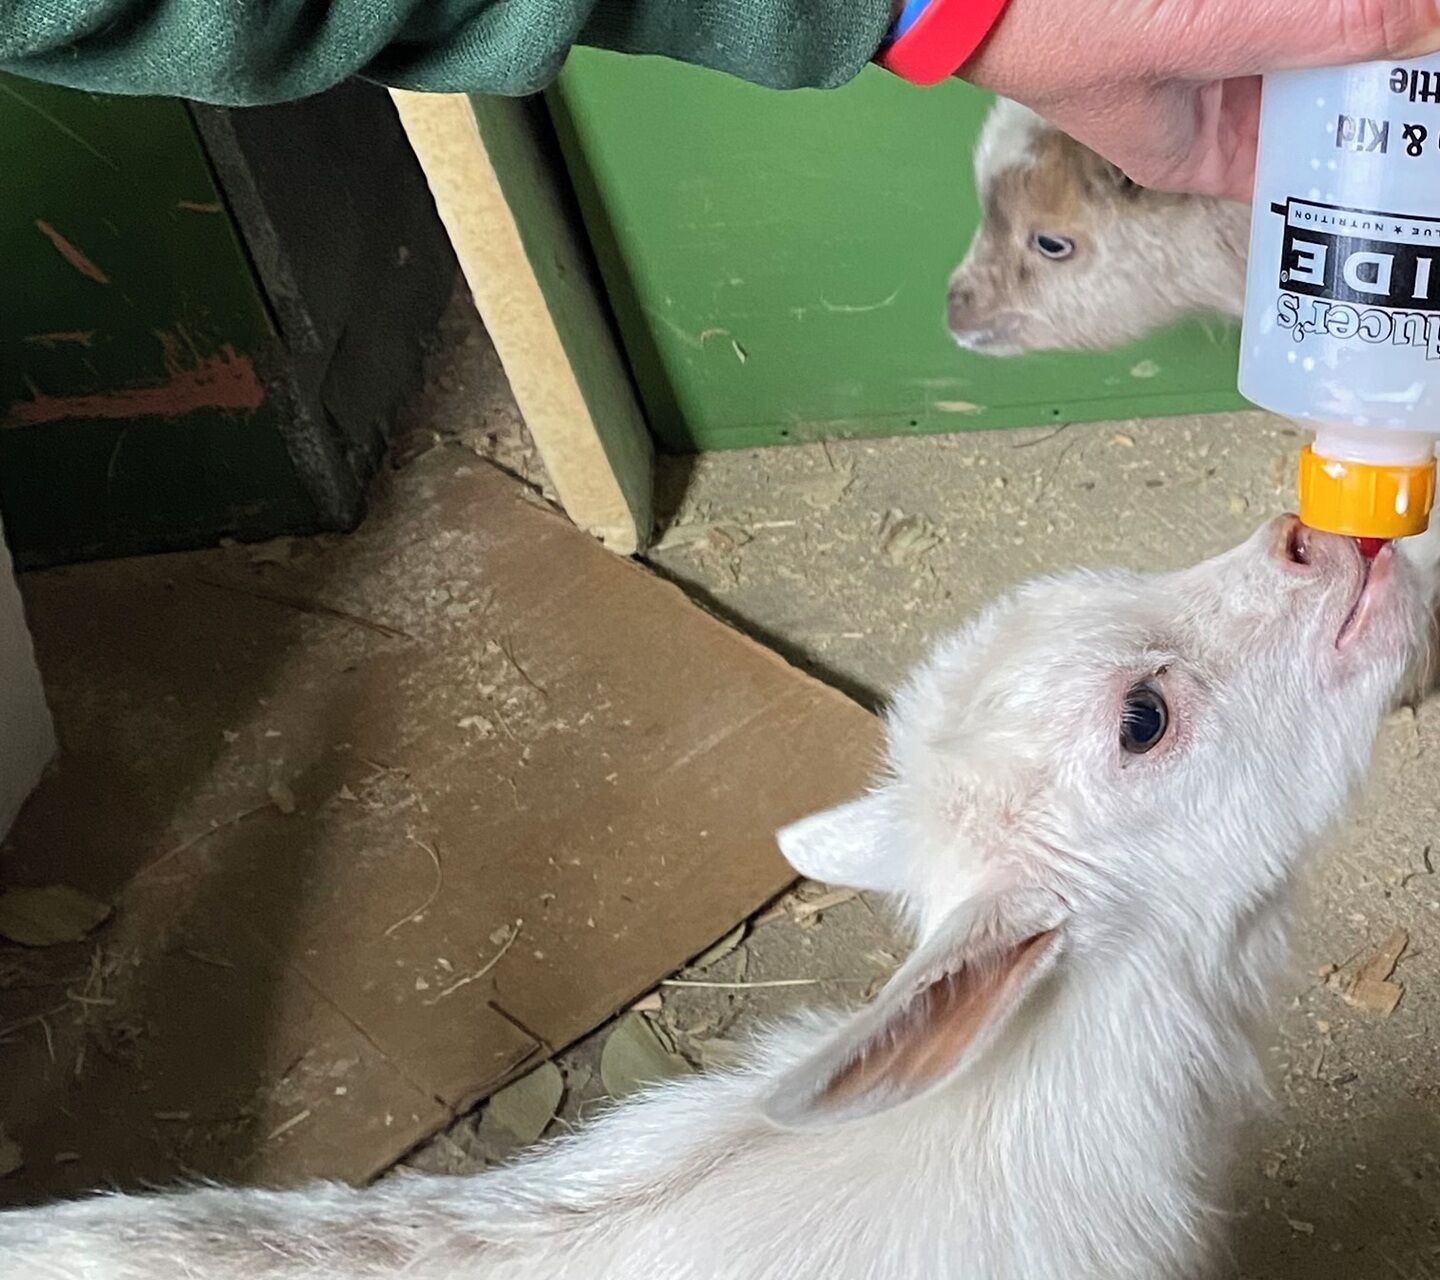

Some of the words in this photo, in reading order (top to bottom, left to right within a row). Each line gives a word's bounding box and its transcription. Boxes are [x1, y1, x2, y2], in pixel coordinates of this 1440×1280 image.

[1336, 114, 1390, 153] Kid
[1402, 124, 1428, 156] &
[1295, 210, 1384, 232] NUTRITION
